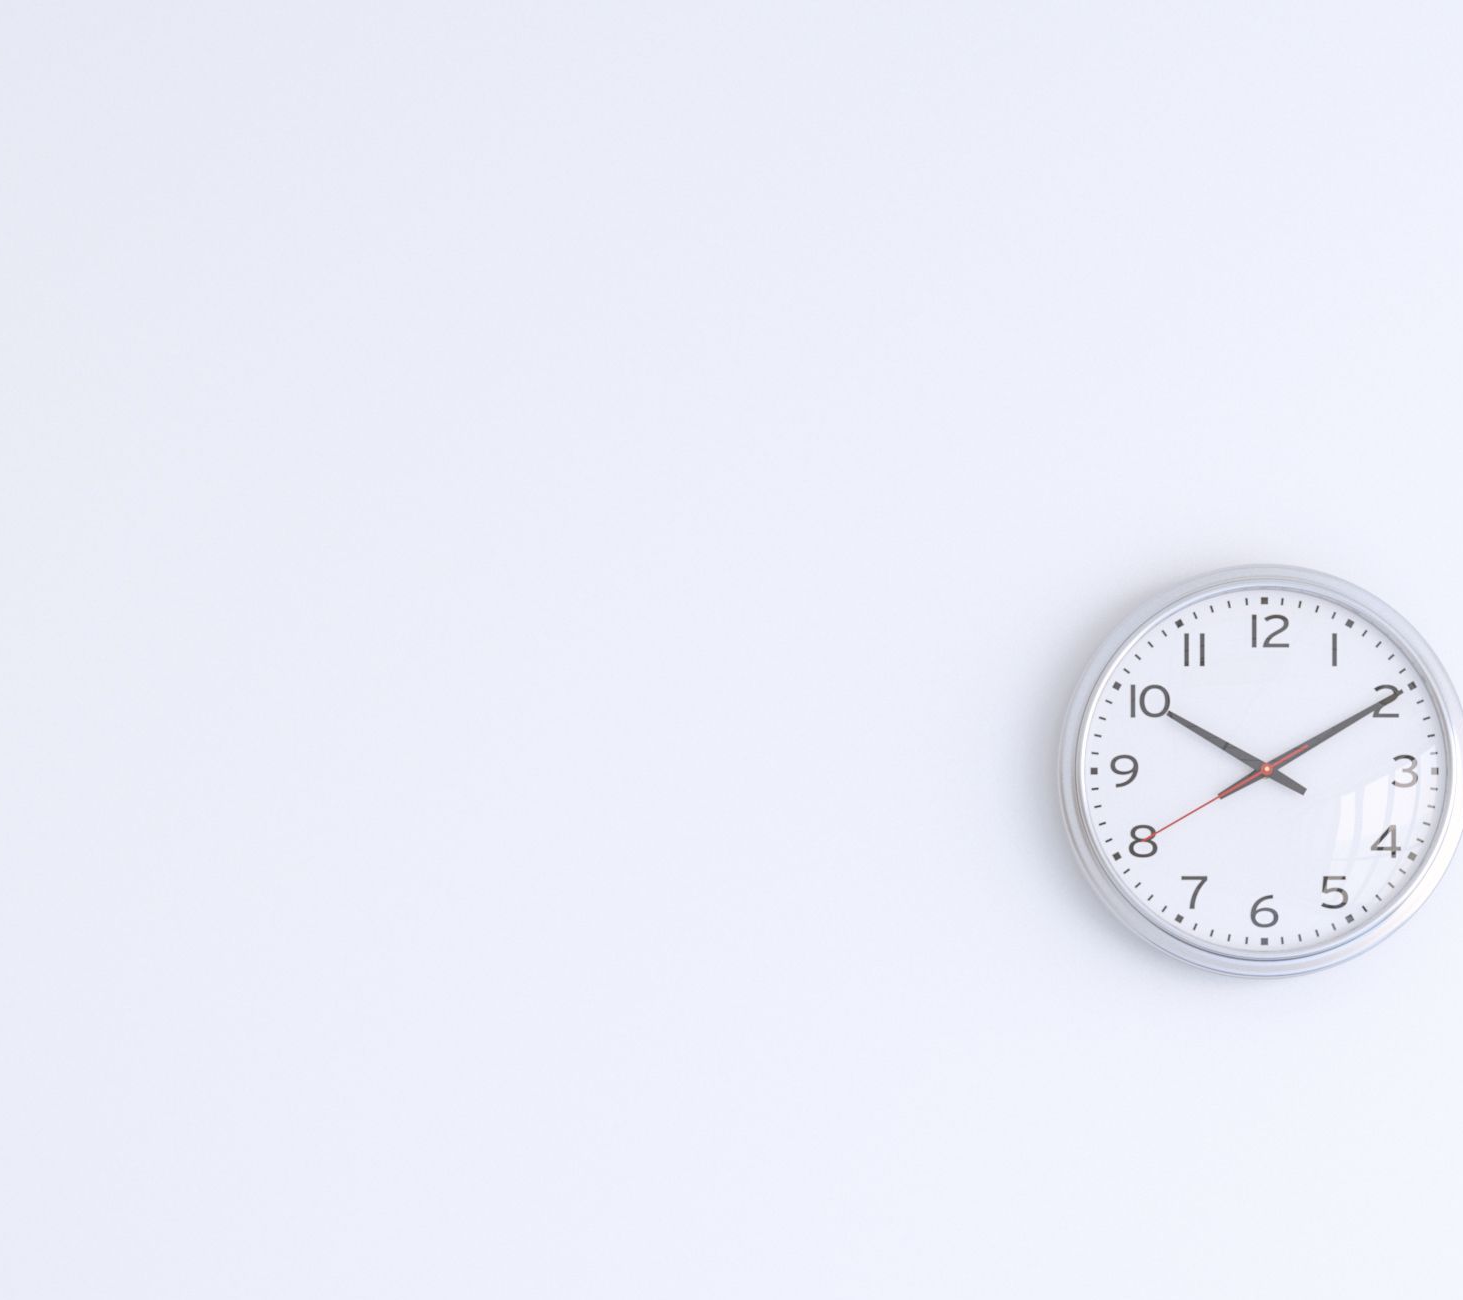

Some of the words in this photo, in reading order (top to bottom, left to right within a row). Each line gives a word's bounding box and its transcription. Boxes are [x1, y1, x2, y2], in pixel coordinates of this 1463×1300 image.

[1250, 613, 1290, 648] 12
[1183, 632, 1206, 667] 11
[1128, 684, 1171, 719] 10
[1372, 684, 1401, 719] 2
[1109, 754, 1140, 788] 9
[1391, 754, 1419, 788] 3
[1128, 824, 1159, 858] 8
[1370, 824, 1402, 859] 4
[1180, 875, 1208, 910] 7
[1320, 875, 1349, 910] 5
[1249, 894, 1280, 928] 6
